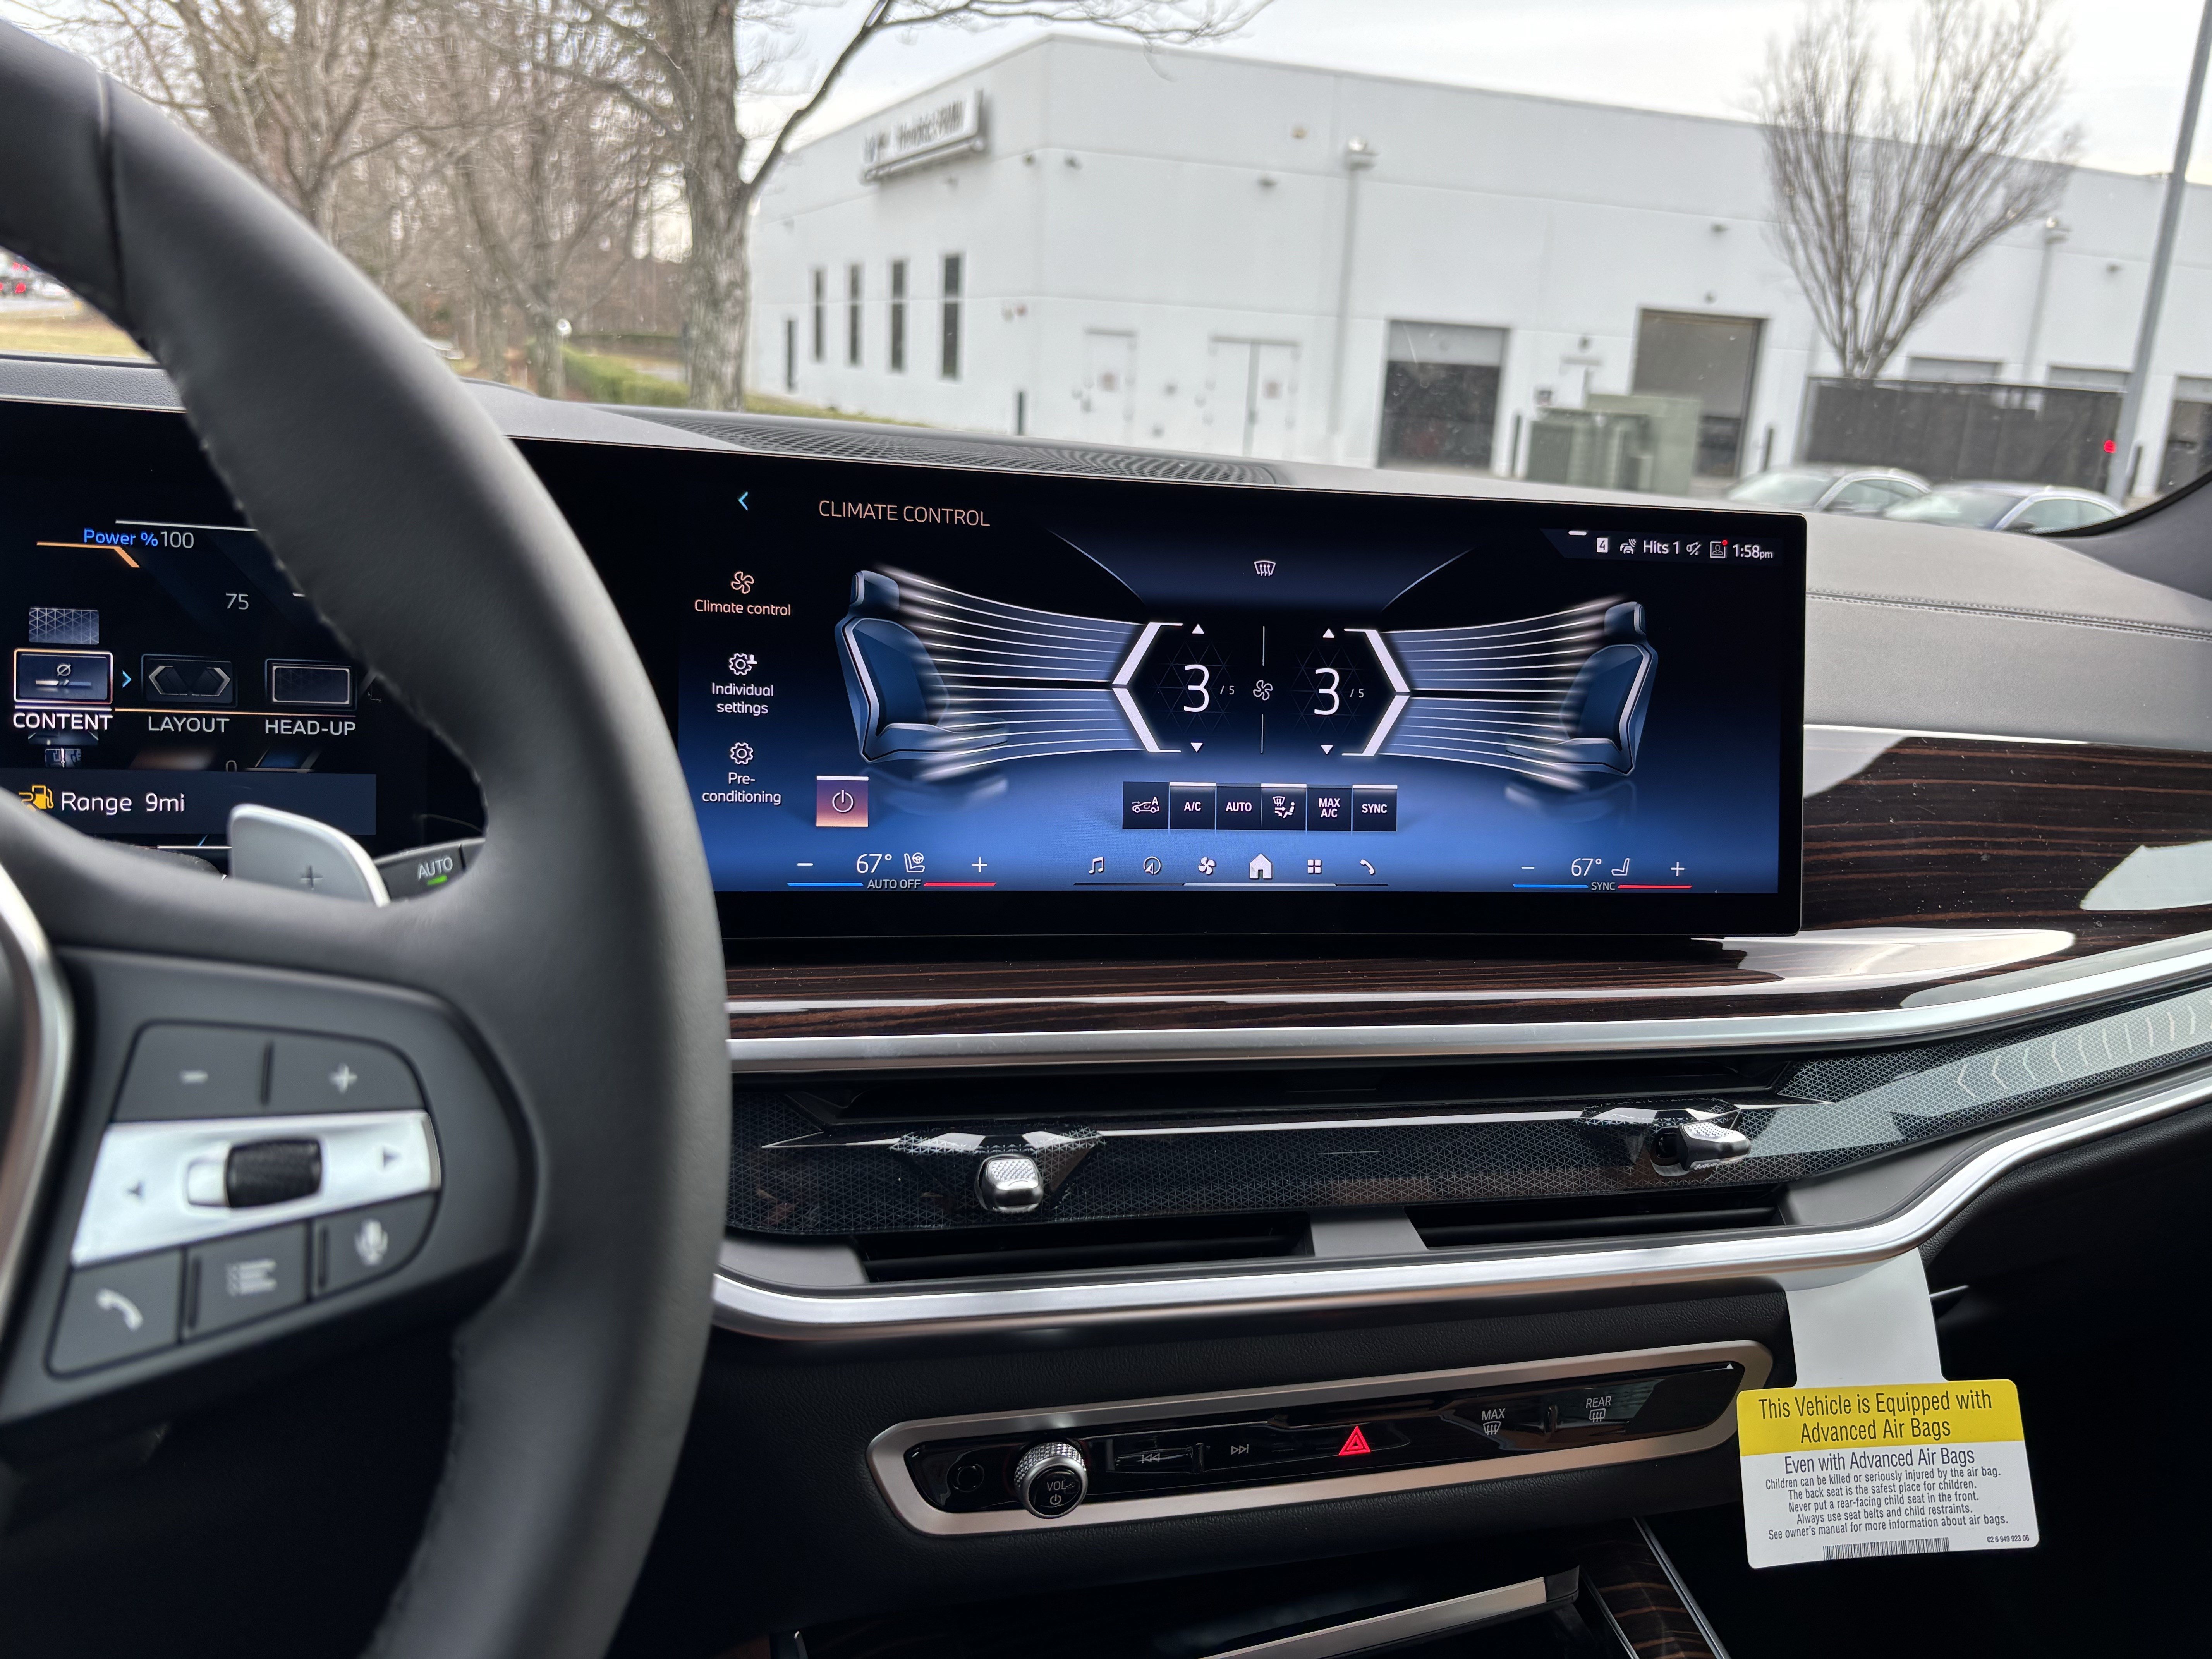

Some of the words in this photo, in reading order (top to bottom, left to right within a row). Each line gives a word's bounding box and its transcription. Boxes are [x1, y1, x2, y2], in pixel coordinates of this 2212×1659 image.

[820, 501, 898, 520] CLIMATE
[904, 507, 990, 526] CONTROL
[83, 529, 136, 546] Power
[161, 532, 194, 548] 100
[1644, 541, 1669, 554] Hits
[1674, 542, 1679, 554] 1
[1733, 545, 1773, 560] 1:58pm
[227, 594, 249, 610] 75
[696, 600, 744, 613] Climate
[747, 603, 791, 616] control
[713, 683, 774, 696] Individual
[1184, 665, 1209, 712] 3
[1315, 668, 1340, 715] 3
[718, 702, 768, 716] settings
[14, 713, 113, 730] CONTENT
[149, 717, 230, 733] LAYOUT
[266, 720, 356, 735] HEAD-UP
[729, 773, 756, 784] Pre-
[62, 793, 132, 815] Range
[146, 794, 184, 812] 9mi
[703, 791, 781, 805] conditioning
[1319, 799, 1340, 807] MAX
[1185, 802, 1201, 811] A/C
[1226, 803, 1252, 812] AUTO
[1321, 809, 1338, 818] A/C
[1363, 804, 1387, 813] SYNC
[418, 857, 453, 880] AUTO
[868, 880, 897, 889] AUTO
[900, 880, 921, 888] OFF
[1586, 1396, 1611, 1408] REAR
[1758, 1398, 1790, 1419] This
[1795, 1395, 1851, 1417] Vehicle
[1857, 1394, 1870, 1413] is
[1876, 1390, 1950, 1416] Equipped
[1956, 1389, 1992, 1409] with
[1482, 1408, 1505, 1420] MAX
[1801, 1419, 1876, 1443] Advanced
[1883, 1419, 1905, 1439] Air
[1911, 1418, 1950, 1441] Bags
[1785, 1456, 1814, 1474] Even
[1818, 1453, 1845, 1471] with
[1850, 1449, 1913, 1469] Advanced
[1918, 1448, 1936, 1466] Air
[1941, 1448, 1975, 1467] Bags
[1766, 1478, 1797, 1489] Children
[1801, 1478, 1814, 1486] can
[1817, 1475, 1826, 1485] be
[1829, 1473, 1850, 1484] killed
[1865, 1470, 1902, 1482] seriously
[1906, 1468, 1934, 1481] injured
[1937, 1468, 1948, 1480] by
[1950, 1468, 1964, 1477] the
[1967, 1467, 1978, 1477] air
[1981, 1466, 2001, 1478] bag.
[1047, 1481, 1066, 1491] VOL
[1788, 1489, 1802, 1500] The
[1805, 1487, 1824, 1498] back
[1827, 1486, 1843, 1497] seat
[1846, 1486, 1853, 1495] is
[1855, 1484, 1869, 1494] the
[1871, 1483, 1896, 1494] safest
[1899, 1482, 1920, 1494] place
[1923, 1481, 1936, 1491] for
[1939, 1479, 1977, 1490] children.
[1789, 1502, 1811, 1513] Never
[1814, 1500, 1827, 1513] put
[1837, 1497, 1881, 1508] rear-facing
[1884, 1494, 1904, 1505] child
[1908, 1494, 1925, 1504] seat
[1938, 1492, 1952, 1502] the
[1954, 1491, 1979, 1501] front.
[1797, 1514, 1824, 1525] Always
[1827, 1513, 1841, 1522] use
[1844, 1510, 1861, 1520] seat
[1863, 1508, 1884, 1518] belts
[1887, 1506, 1901, 1517] and
[1905, 1505, 1925, 1516] child
[1929, 1504, 1972, 1515] restraints.
[1769, 1530, 1782, 1540] See
[1819, 1523, 1847, 1535] manual
[1850, 1522, 1862, 1532] for
[1865, 1522, 1886, 1531] more
[1889, 1518, 1938, 1529] information
[1941, 1516, 1966, 1526] about
[1969, 1515, 1980, 1525] air
[1984, 1514, 2008, 1526] bags.
